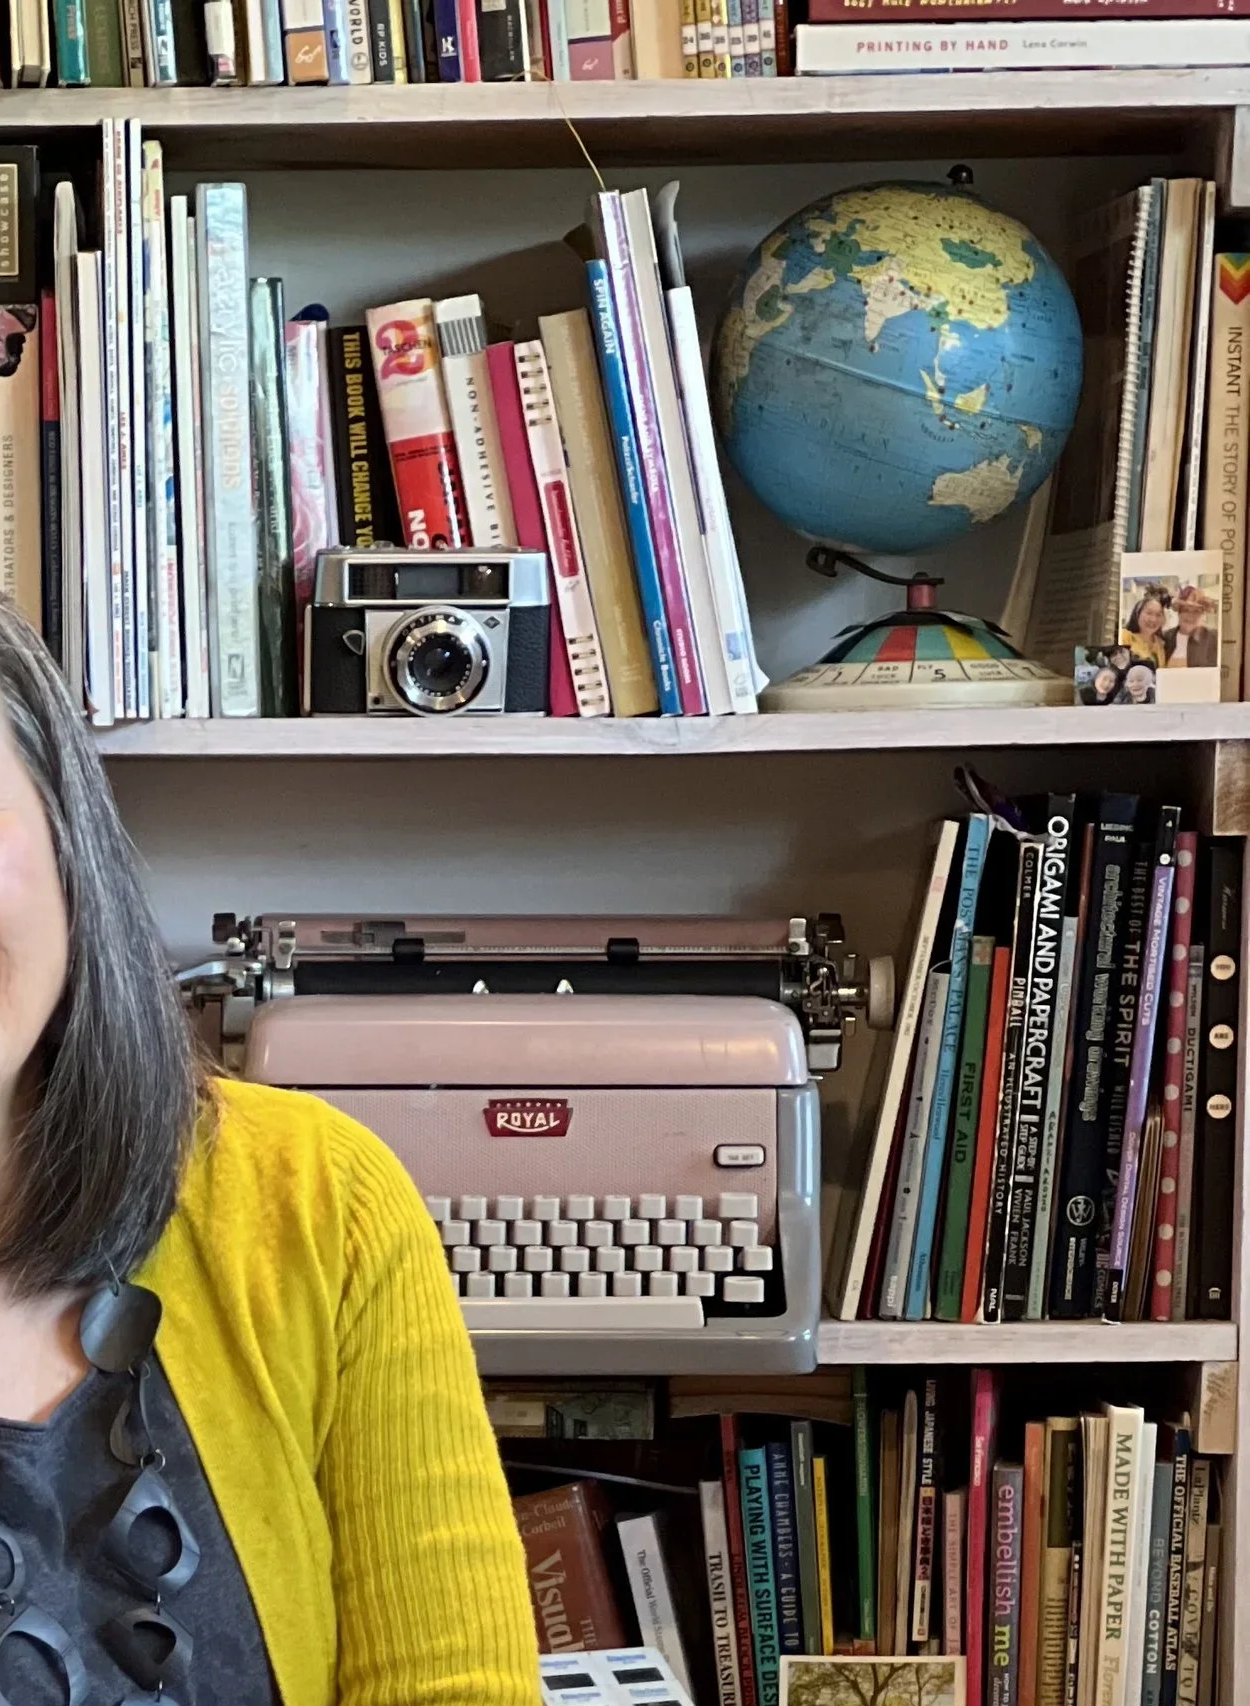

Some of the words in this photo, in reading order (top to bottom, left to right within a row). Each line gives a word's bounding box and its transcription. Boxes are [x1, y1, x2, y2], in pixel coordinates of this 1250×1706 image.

[856, 40, 934, 53] PRINTING
[940, 40, 958, 51] BY
[965, 38, 1010, 51] HAND
[0, 172, 10, 269] showcase
[592, 278, 607, 310] SPIN
[342, 331, 361, 370] THIS
[382, 338, 433, 356] TASCHEN
[599, 311, 616, 355] AGAIN
[1226, 325, 1243, 397] INSTANT
[345, 373, 366, 419] BOOK
[1224, 402, 1241, 438] THE
[348, 421, 369, 459] WILL
[465, 375, 496, 512] NON-ADHESIVE
[1, 434, 16, 508] DESIGNERS
[351, 460, 374, 525] CHANGE
[1222, 441, 1241, 498] STORY
[1219, 500, 1237, 526] OF
[933, 668, 947, 681] 5
[963, 844, 981, 878] THE
[1023, 851, 1035, 900] COLMER
[1038, 815, 1071, 920] ORIGAMI
[1095, 863, 1123, 970] architectural
[1152, 875, 1169, 930] VINTAGE
[1033, 923, 1059, 974] AND
[1121, 942, 1142, 987] THE
[1145, 929, 1162, 989] MORTISED
[942, 988, 965, 1054] PALACE
[1010, 977, 1027, 1027] PINBALL
[1084, 972, 1111, 1042] working
[1141, 990, 1156, 1026] CUTS
[1019, 976, 1054, 1110] PAPERCRAFT
[1113, 992, 1136, 1068] SPIRIT
[957, 1061, 977, 1121] FIRST
[1078, 1043, 1102, 1122] drawings
[1182, 1026, 1198, 1113] DUCTIGAMI
[496, 1111, 561, 1129] ROYAL
[998, 1076, 1015, 1160] ILLUSTRATED
[953, 1129, 969, 1164] AID
[1015, 1140, 1027, 1172] GUIDE
[993, 1164, 1007, 1215] HISTORY
[1012, 1188, 1025, 1225] VIVIEN
[1023, 1189, 1035, 1214] PAUL
[1007, 1230, 1020, 1266] FRANK
[1017, 1214, 1032, 1268] JACKSON
[987, 1287, 998, 1313] NAL
[925, 1379, 938, 1407] LIVING
[922, 1409, 937, 1454] JAPANESE
[771, 1451, 789, 1487] ANNE
[920, 1457, 934, 1485] STYLE
[1113, 1432, 1134, 1500] MADE
[1174, 1454, 1188, 1482] THE
[743, 1463, 766, 1536] PLAYING
[1171, 1484, 1187, 1552] OFFICIAL
[520, 1514, 567, 1537] Corbeil
[773, 1491, 794, 1559] CHAMBERS
[1108, 1506, 1130, 1568] WITH
[637, 1548, 648, 1565] The
[750, 1541, 770, 1585] WITH
[994, 1483, 1022, 1618] embellish
[1150, 1538, 1166, 1604] BEYOND
[640, 1565, 656, 1601] Official
[708, 1551, 726, 1603] TRASH
[1167, 1553, 1183, 1627] BASEBALL
[713, 1608, 729, 1629] TO
[754, 1588, 777, 1665] SURFACE
[780, 1585, 799, 1626] GUIDE
[1104, 1571, 1126, 1642] PAPER
[782, 1631, 800, 1649] TO
[992, 1623, 1011, 1667] me
[1145, 1609, 1161, 1675] COTTON
[1164, 1628, 1180, 1672] ATLAS
